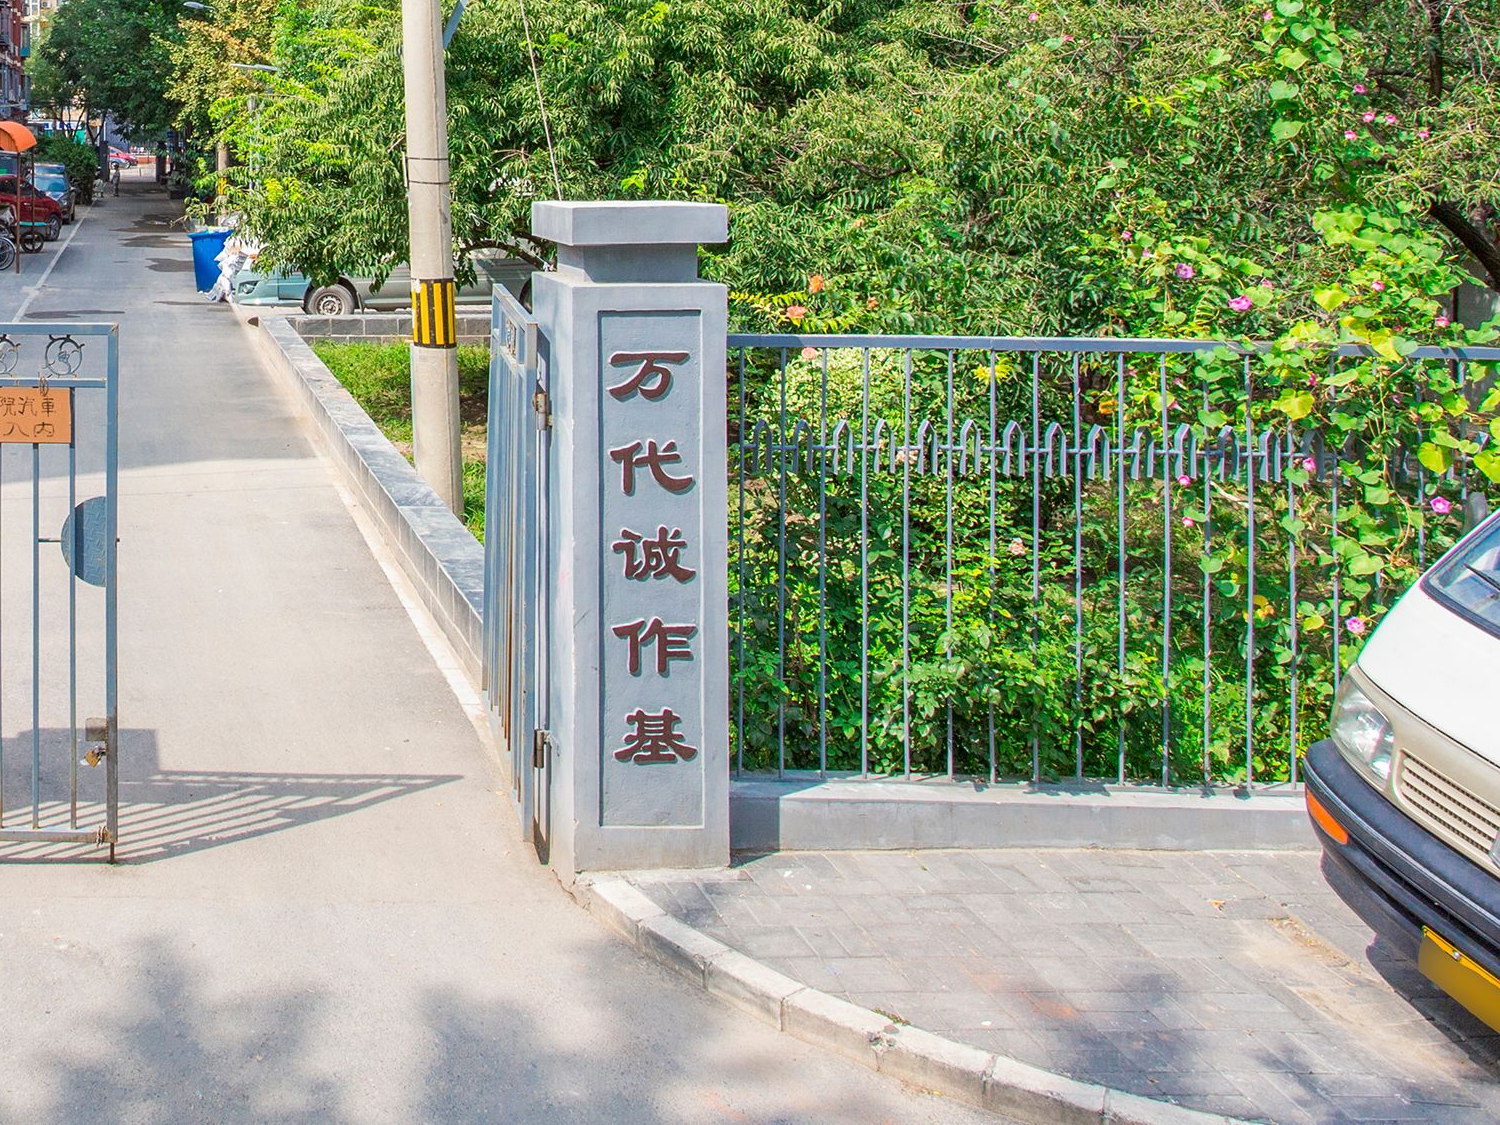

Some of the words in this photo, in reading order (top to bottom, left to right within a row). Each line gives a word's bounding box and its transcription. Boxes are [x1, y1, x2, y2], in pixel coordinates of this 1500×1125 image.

[607, 350, 698, 765] 万代诚作基
